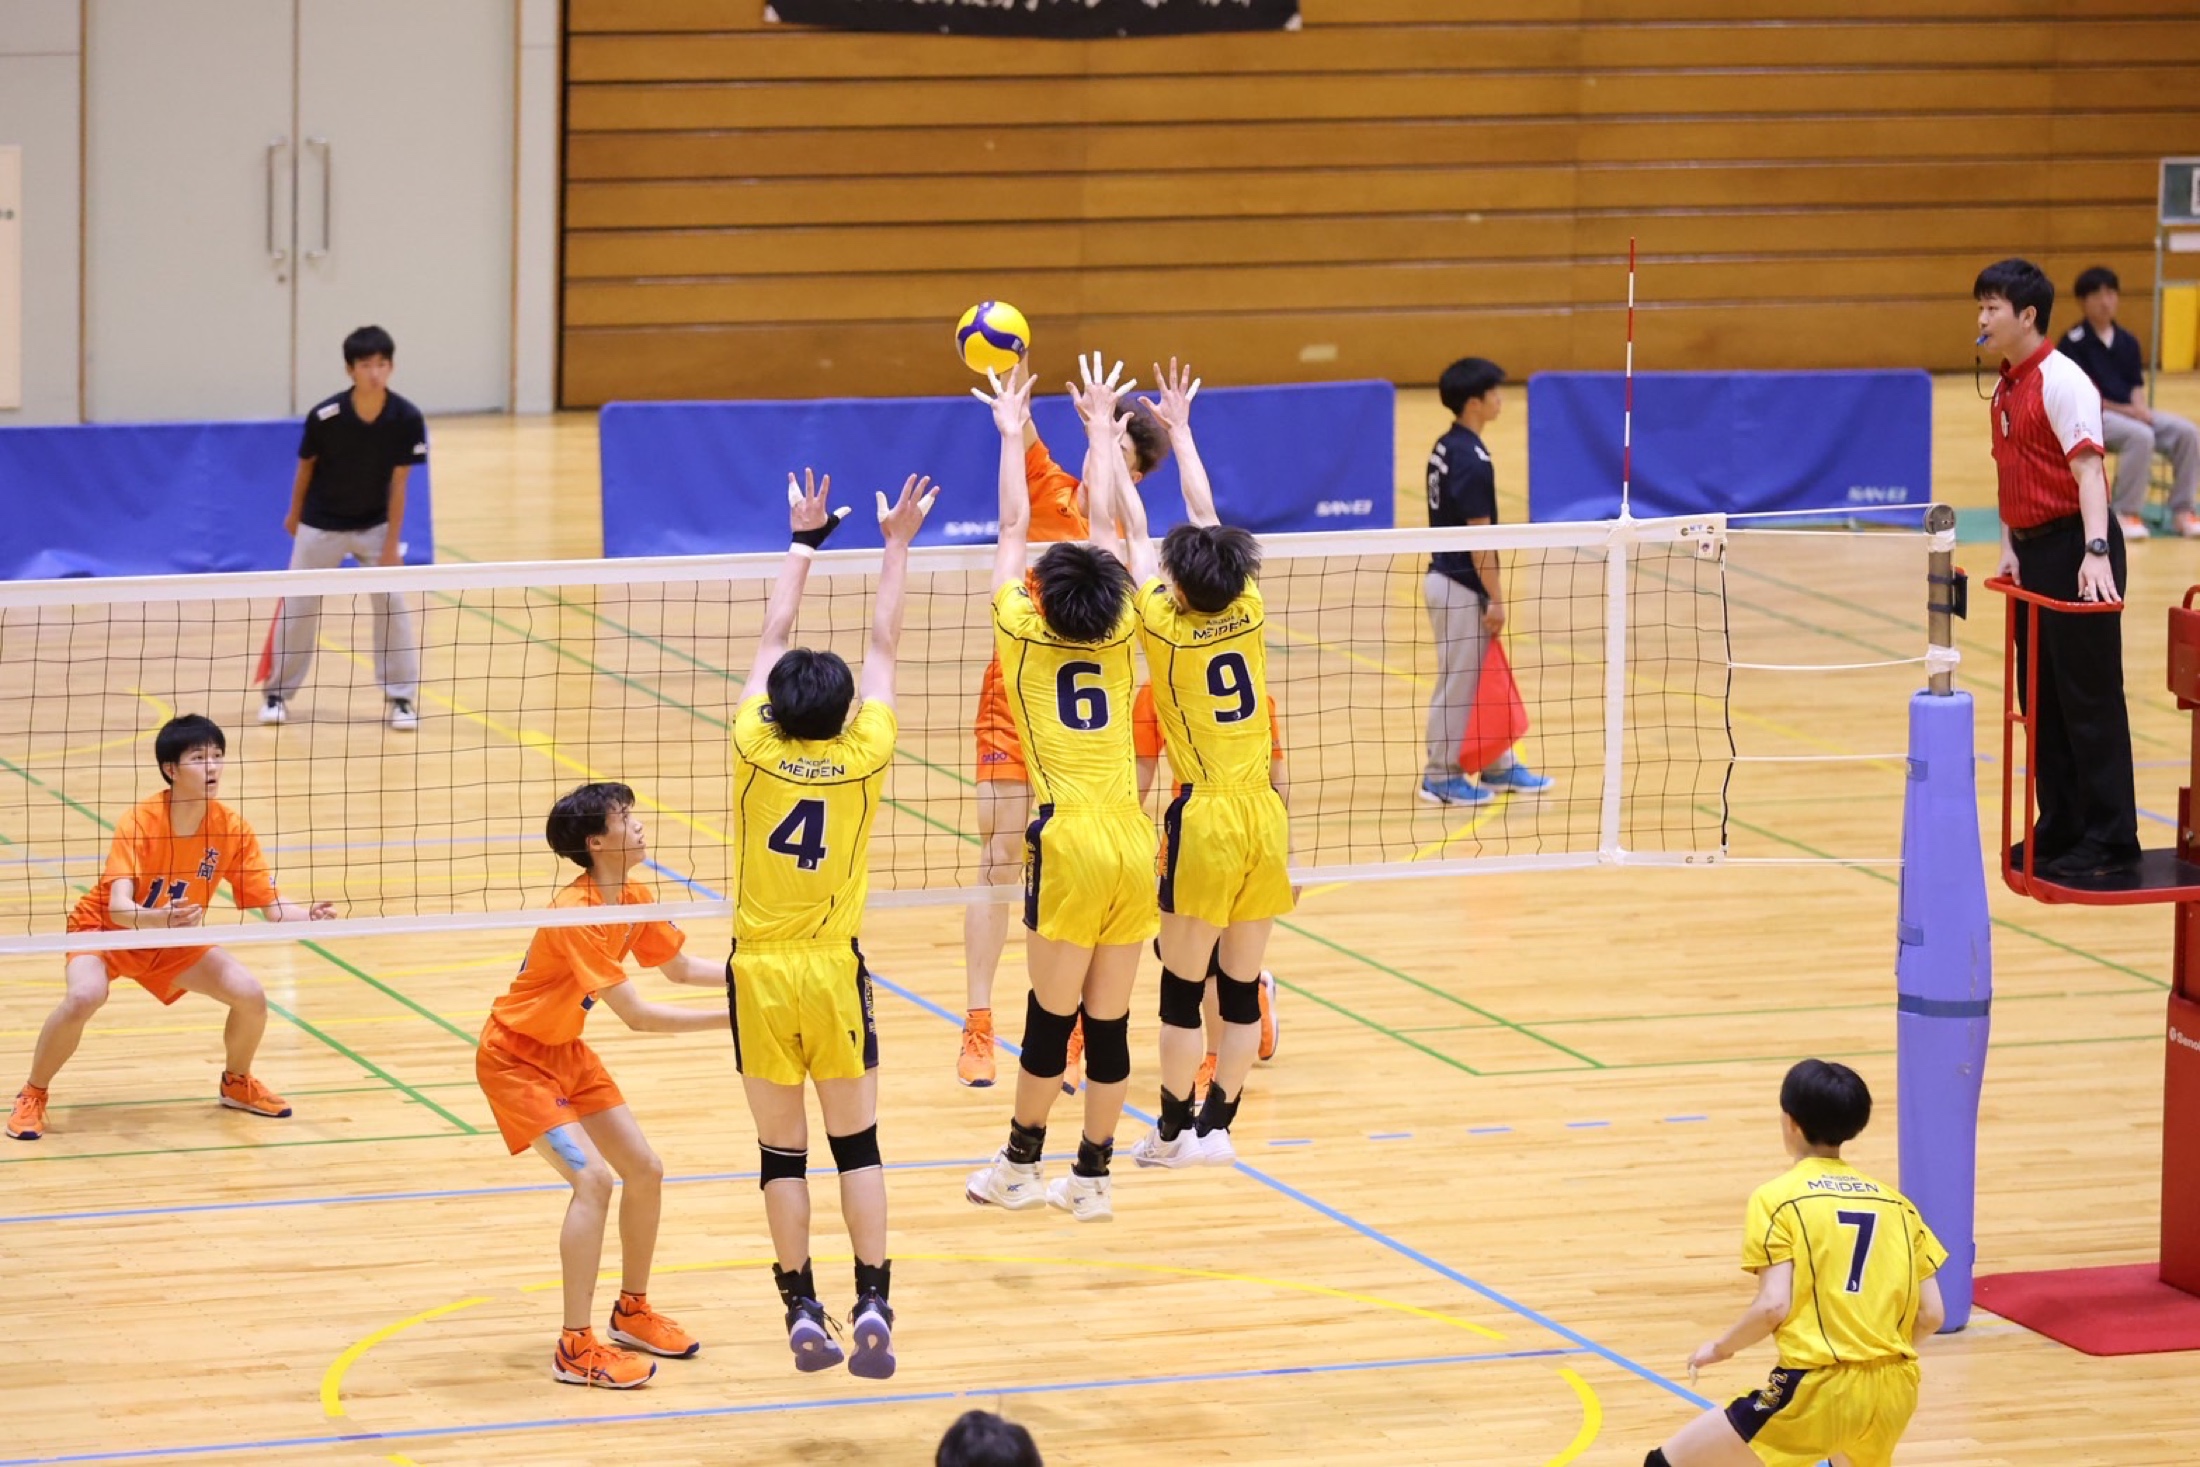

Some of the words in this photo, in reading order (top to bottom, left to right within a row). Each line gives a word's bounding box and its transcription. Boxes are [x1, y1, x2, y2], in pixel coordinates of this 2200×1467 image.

[1192, 614, 1250, 641] MEIDEN
[1056, 660, 1109, 730] 6
[1207, 651, 1258, 724] 9
[778, 760, 845, 779] MEIDEN
[768, 797, 829, 872] 4
[1806, 1180, 1879, 1194] MEIDEN
[1837, 1210, 1878, 1293] 7
